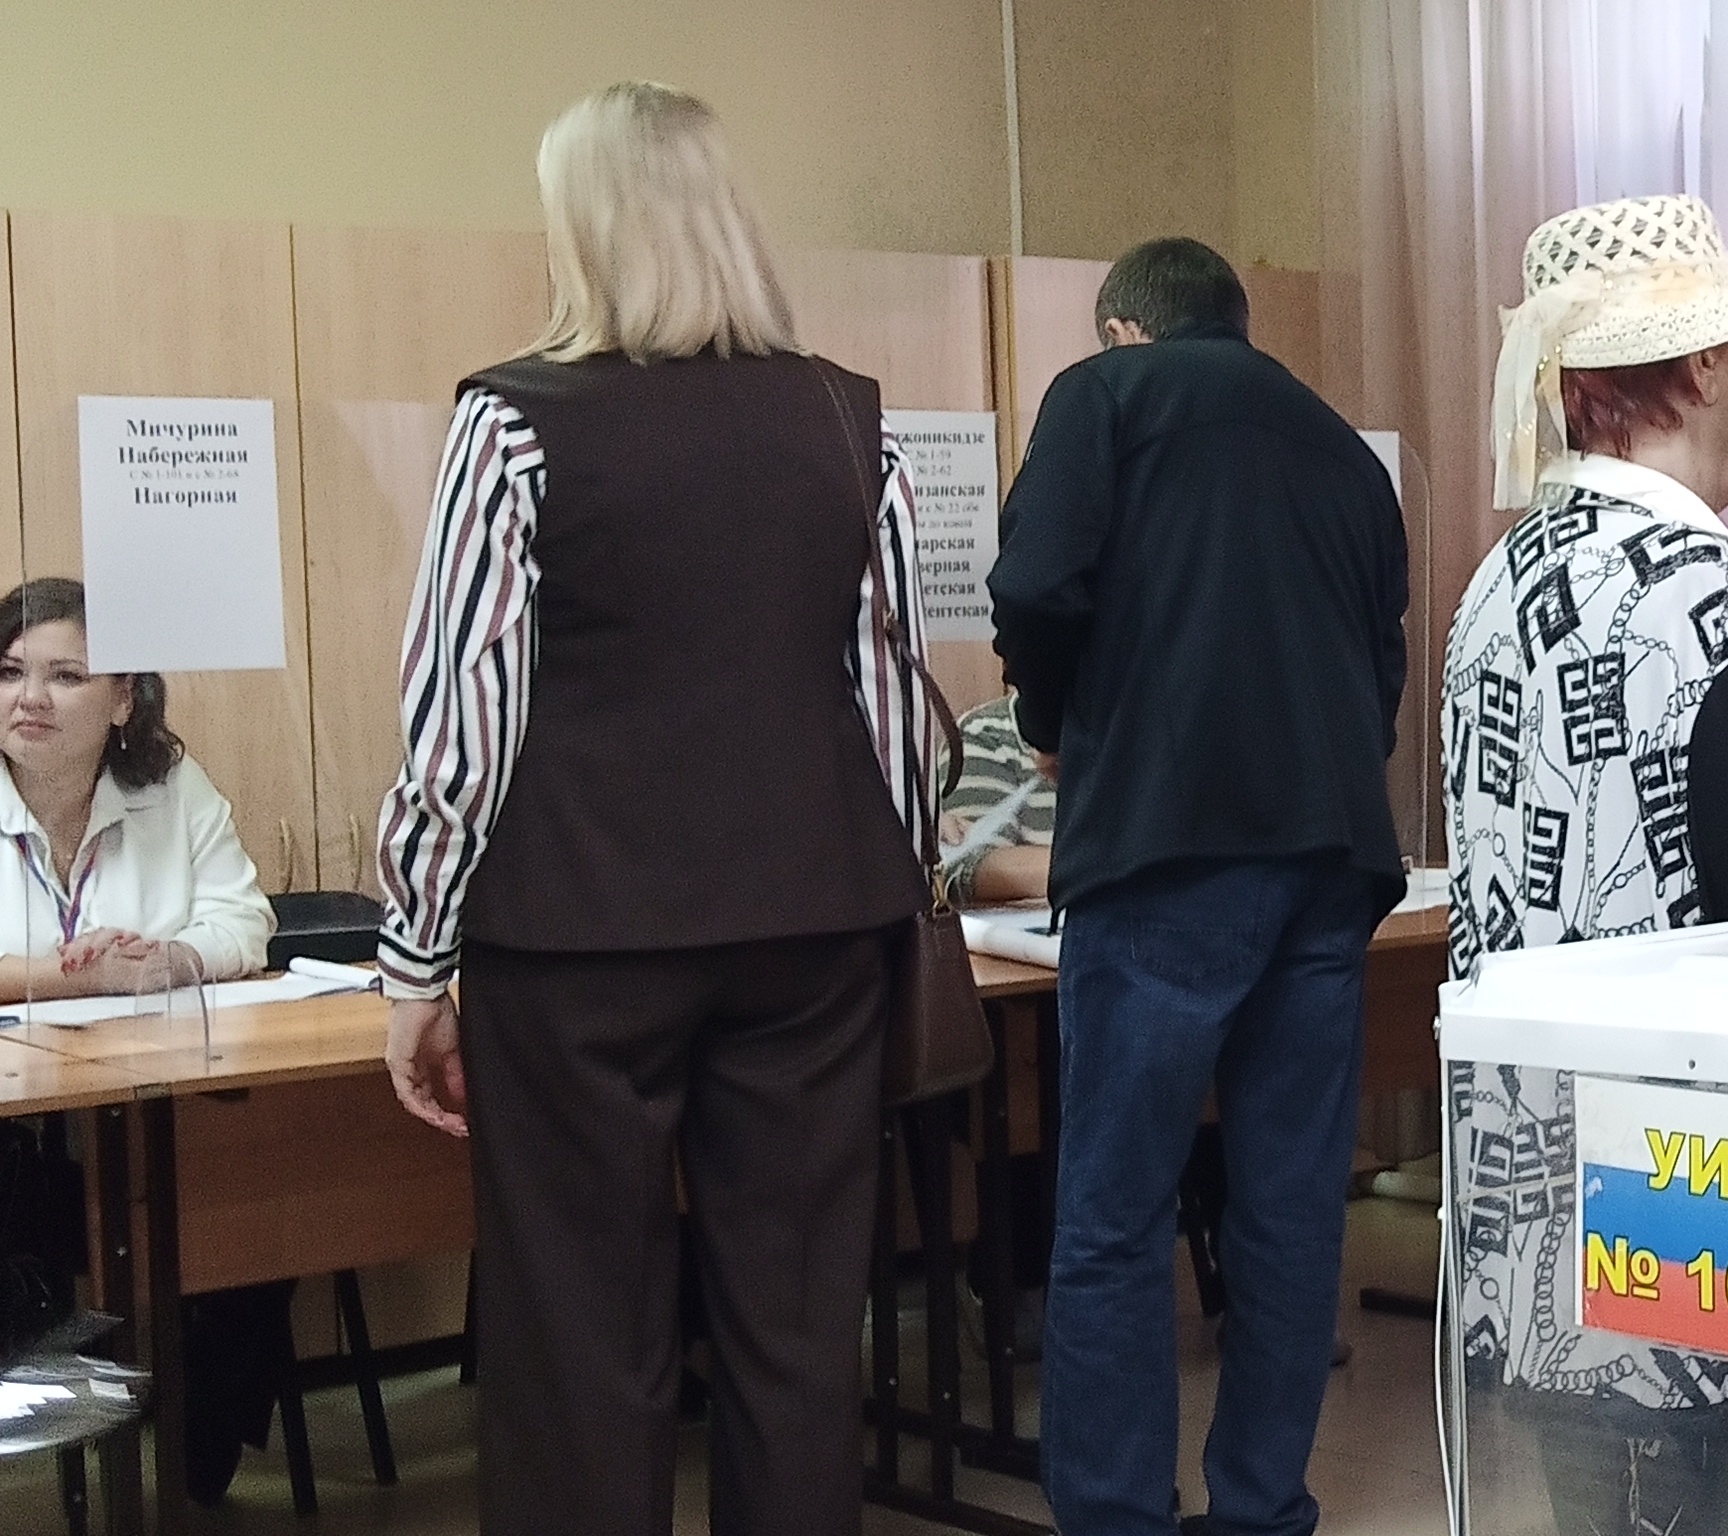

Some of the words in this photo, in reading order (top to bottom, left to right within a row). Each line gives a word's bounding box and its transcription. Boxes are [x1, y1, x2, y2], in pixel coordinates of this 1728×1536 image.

[126, 419, 238, 441] Мичурина
[895, 431, 985, 445] жоникидзе
[118, 446, 248, 468] Набережная
[134, 486, 238, 508] Нагорная
[914, 485, 985, 498] изанская
[917, 538, 975, 554] арская
[924, 582, 976, 596] етская
[925, 605, 989, 618] ентская
[1586, 1230, 1661, 1301] №
